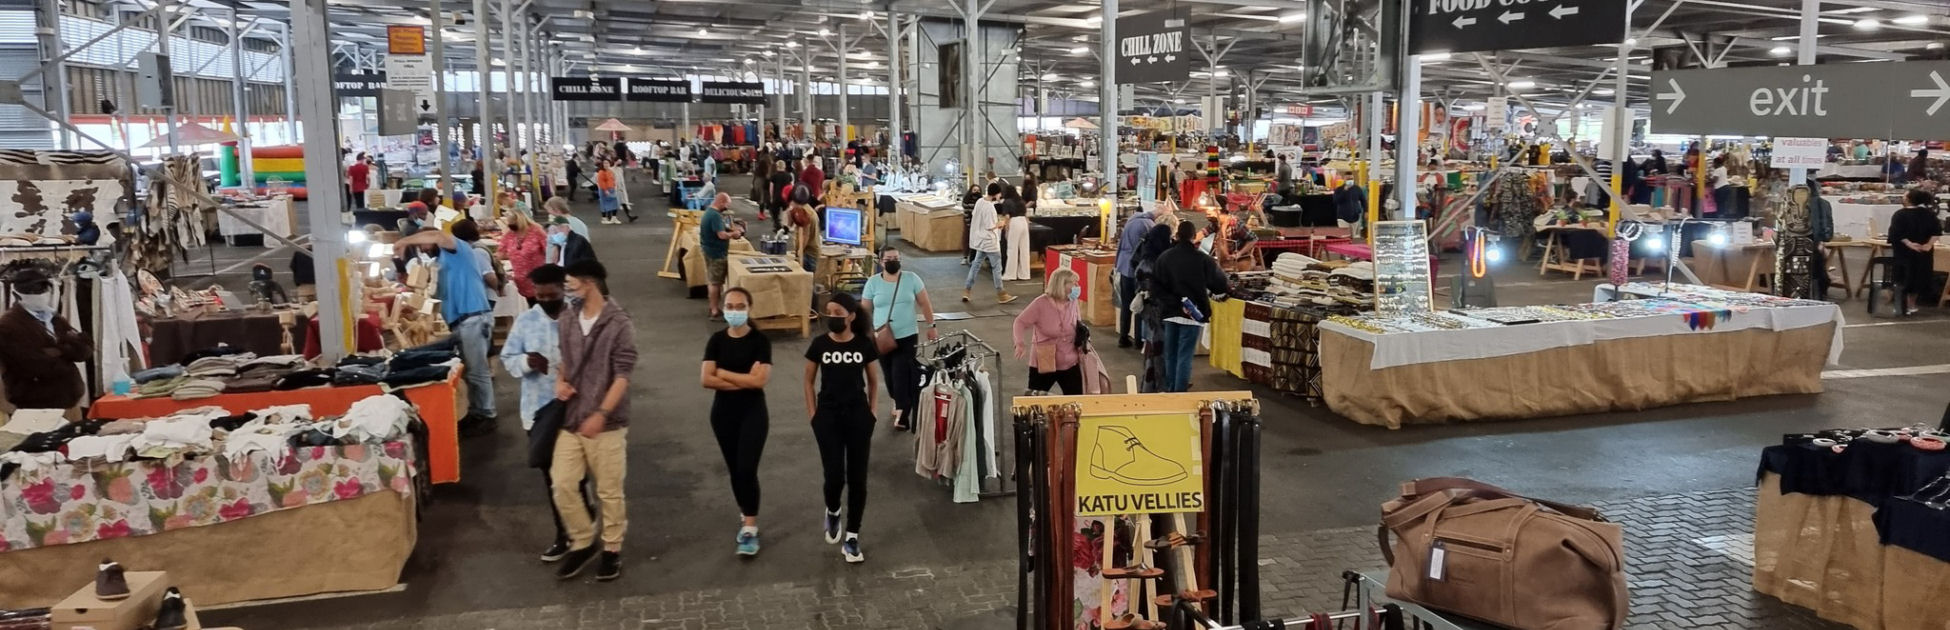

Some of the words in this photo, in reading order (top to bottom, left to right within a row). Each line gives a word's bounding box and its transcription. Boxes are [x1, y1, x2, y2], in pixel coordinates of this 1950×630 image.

[1121, 35, 1151, 57] CHILL
[1153, 31, 1182, 54] ZONE
[559, 85, 588, 94] CHILL
[632, 85, 669, 94] ROOFTOP
[670, 86, 687, 95] BAR
[1749, 74, 1829, 116] exit
[822, 351, 863, 364] COCO
[1079, 494, 1127, 512] KATU
[1131, 491, 1202, 510] VELLIES
